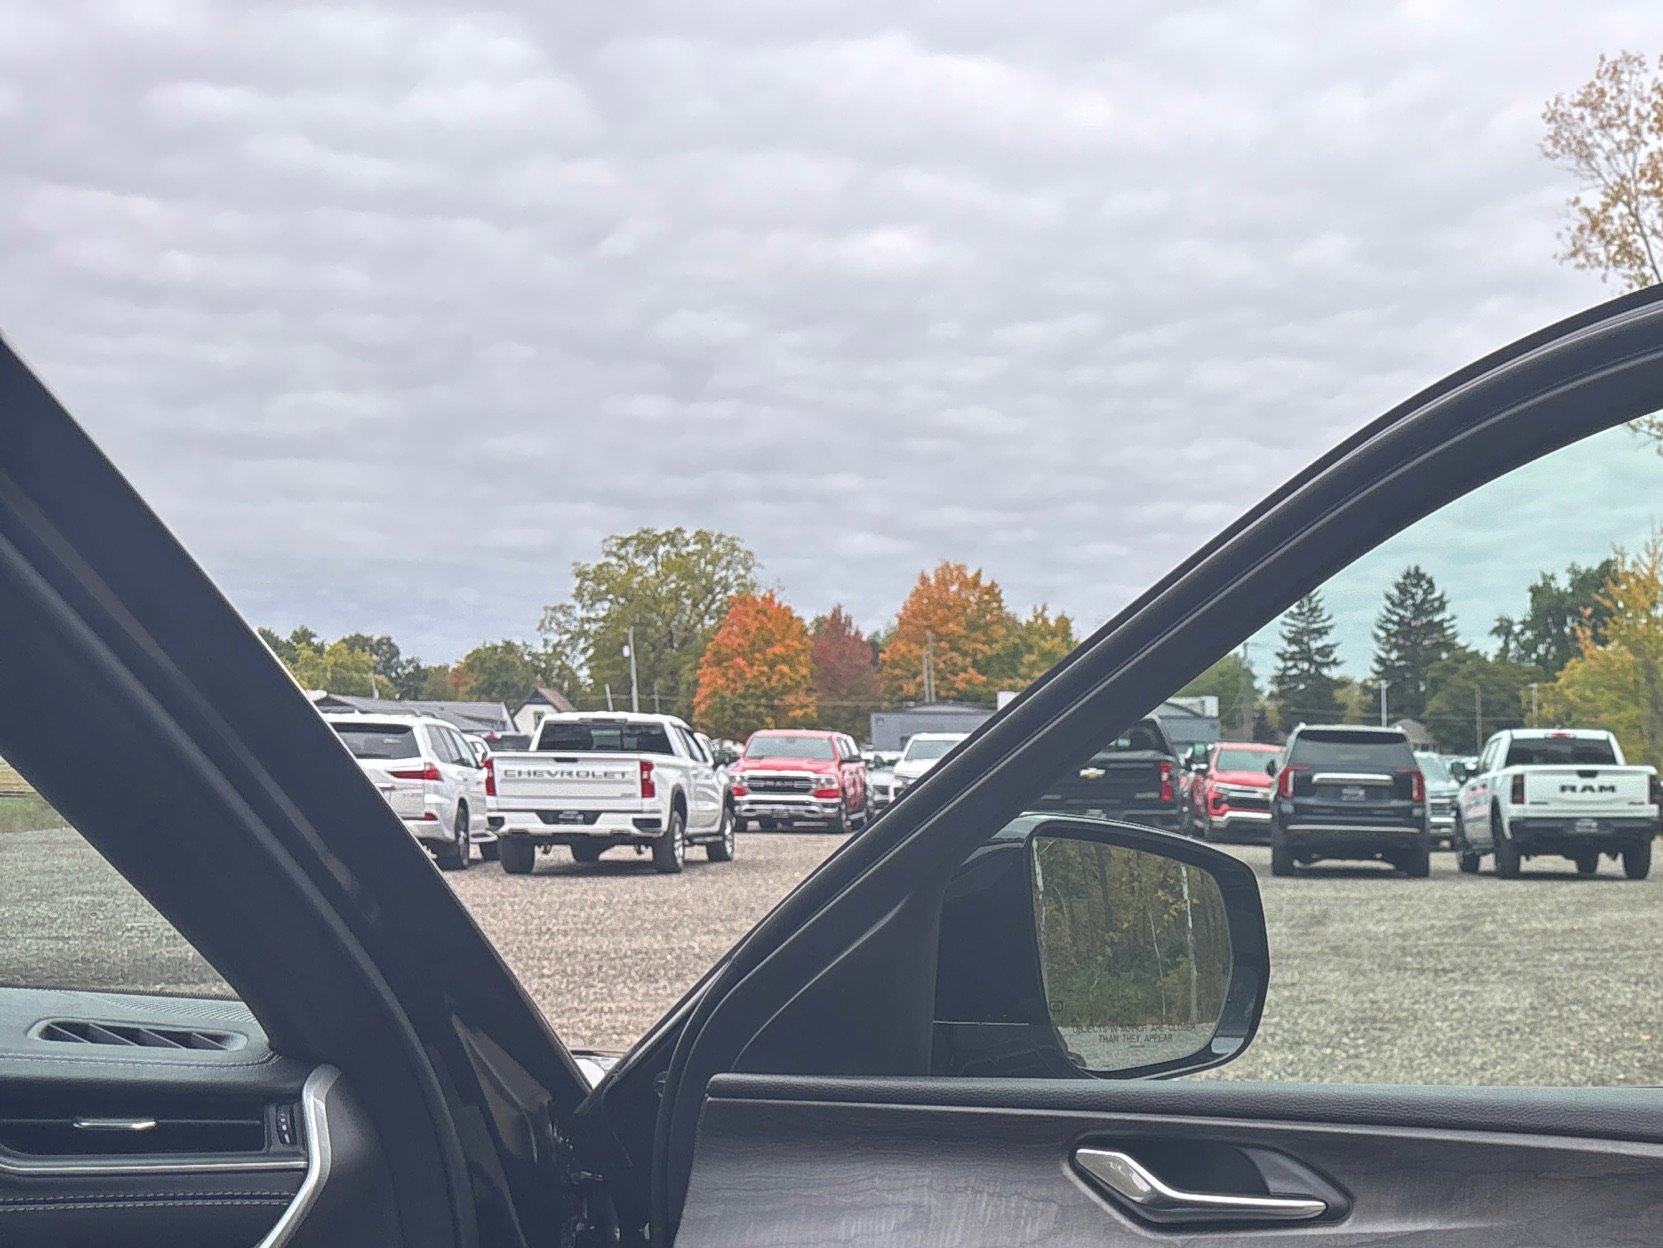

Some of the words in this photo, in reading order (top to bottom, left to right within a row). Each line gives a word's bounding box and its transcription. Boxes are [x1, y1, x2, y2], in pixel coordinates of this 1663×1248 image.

[503, 769, 630, 779] CHEVROLET
[1559, 784, 1617, 794] RAM
[1072, 1024, 1108, 1034] OBJECTS
[1168, 1022, 1196, 1032] CLOSER
[1099, 1034, 1119, 1043] THAN
[1123, 1033, 1141, 1043] THEY
[1144, 1033, 1173, 1043] APPEAR
